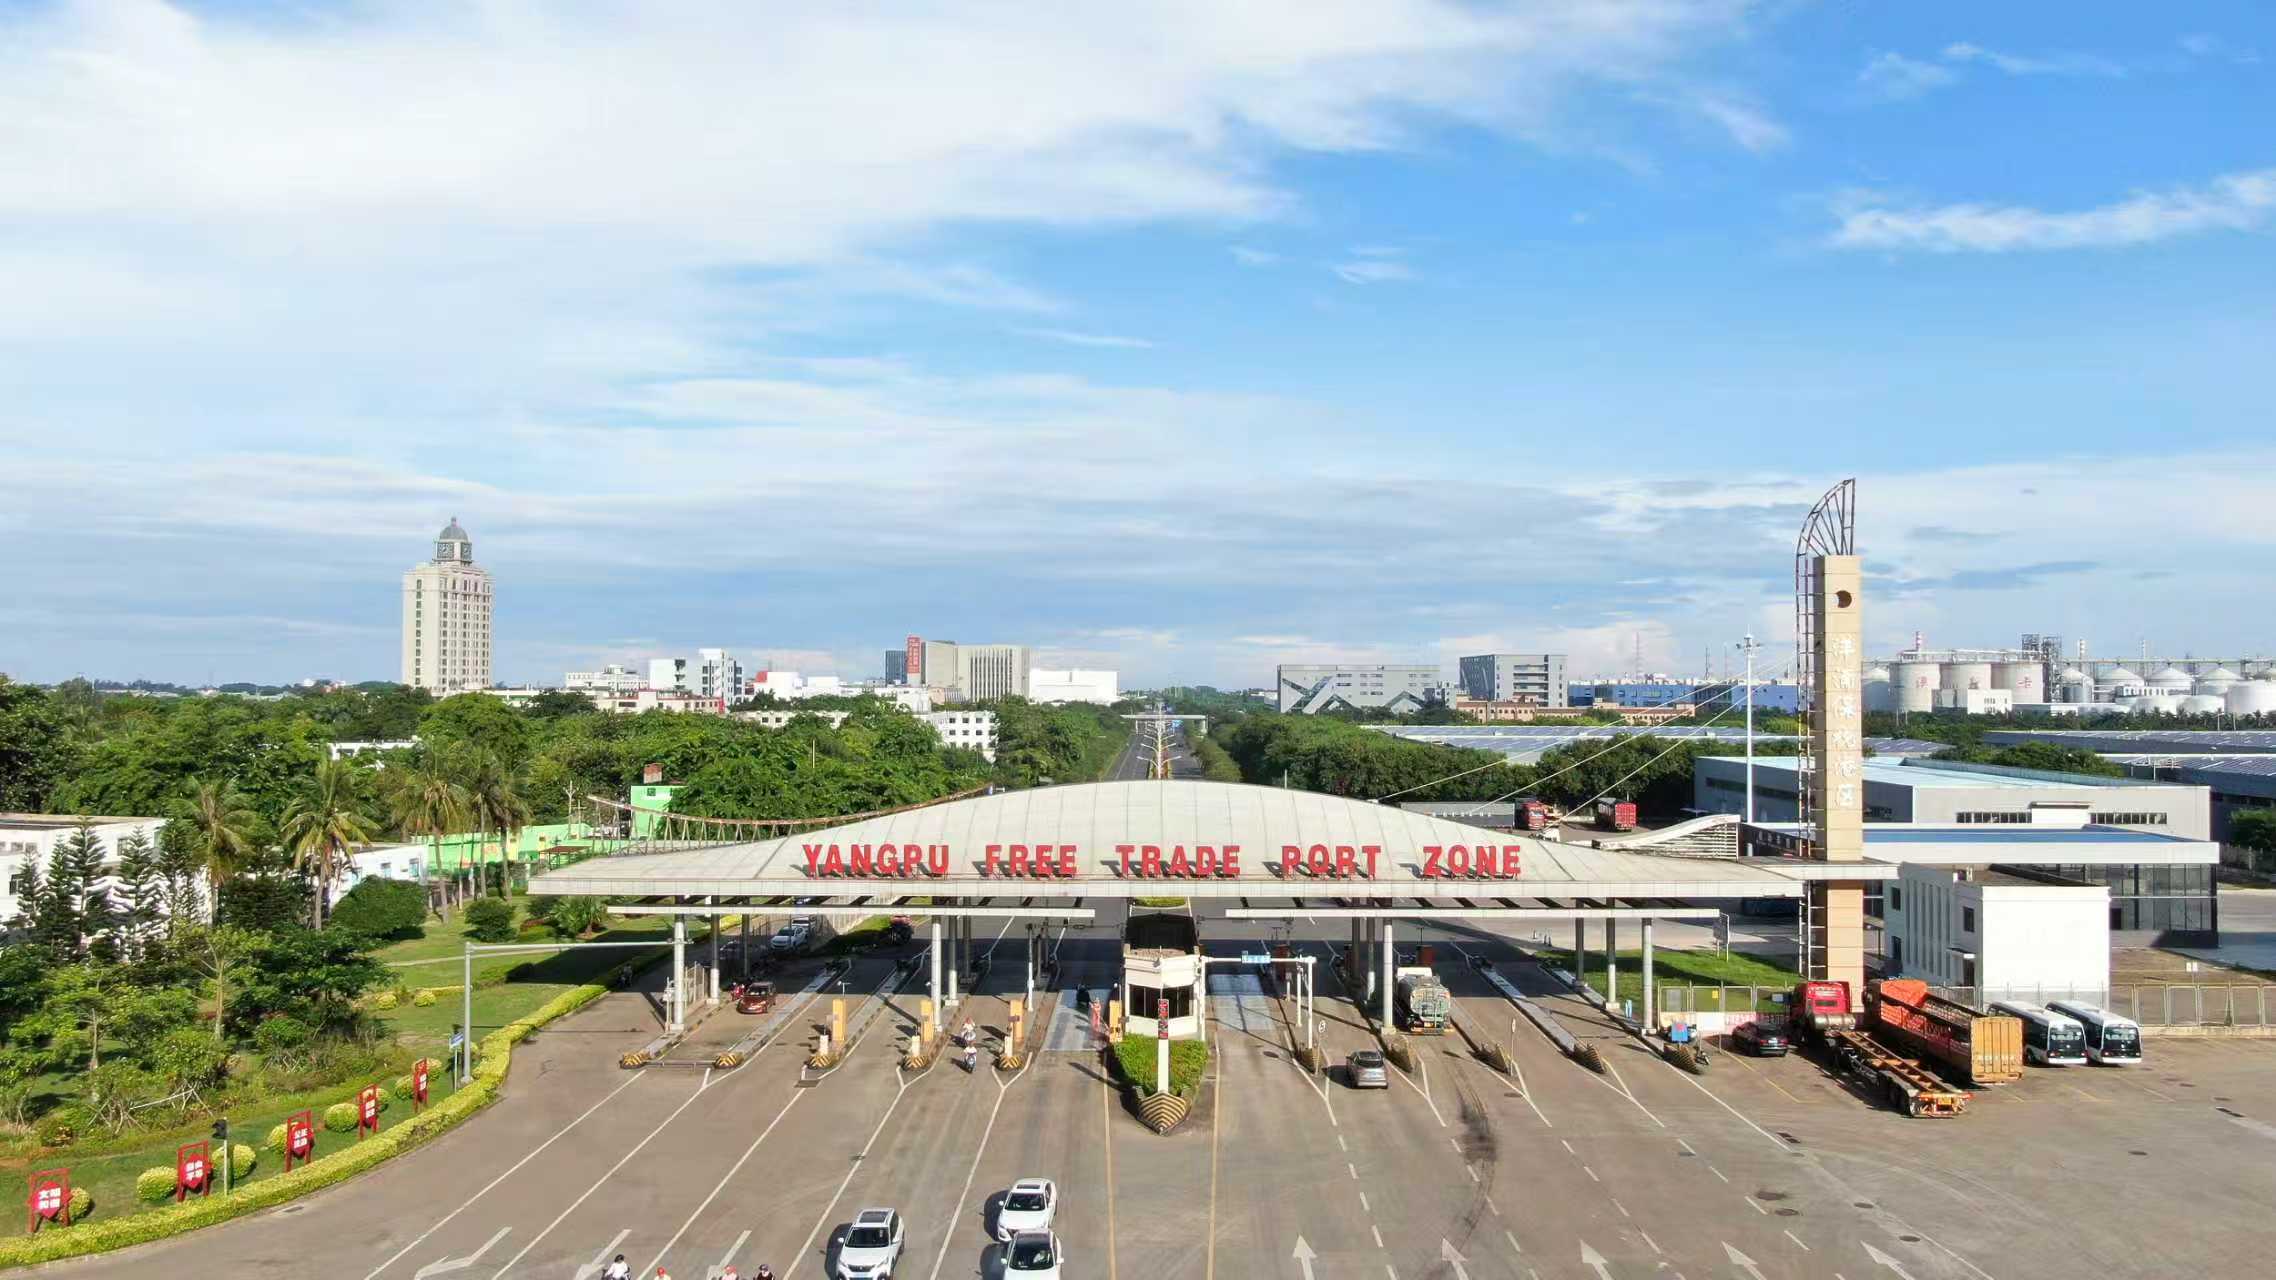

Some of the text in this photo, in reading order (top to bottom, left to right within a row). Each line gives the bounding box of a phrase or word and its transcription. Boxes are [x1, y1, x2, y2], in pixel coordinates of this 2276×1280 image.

[802, 844, 1522, 877] YANGPU FREE TRADE PORT ZONE
